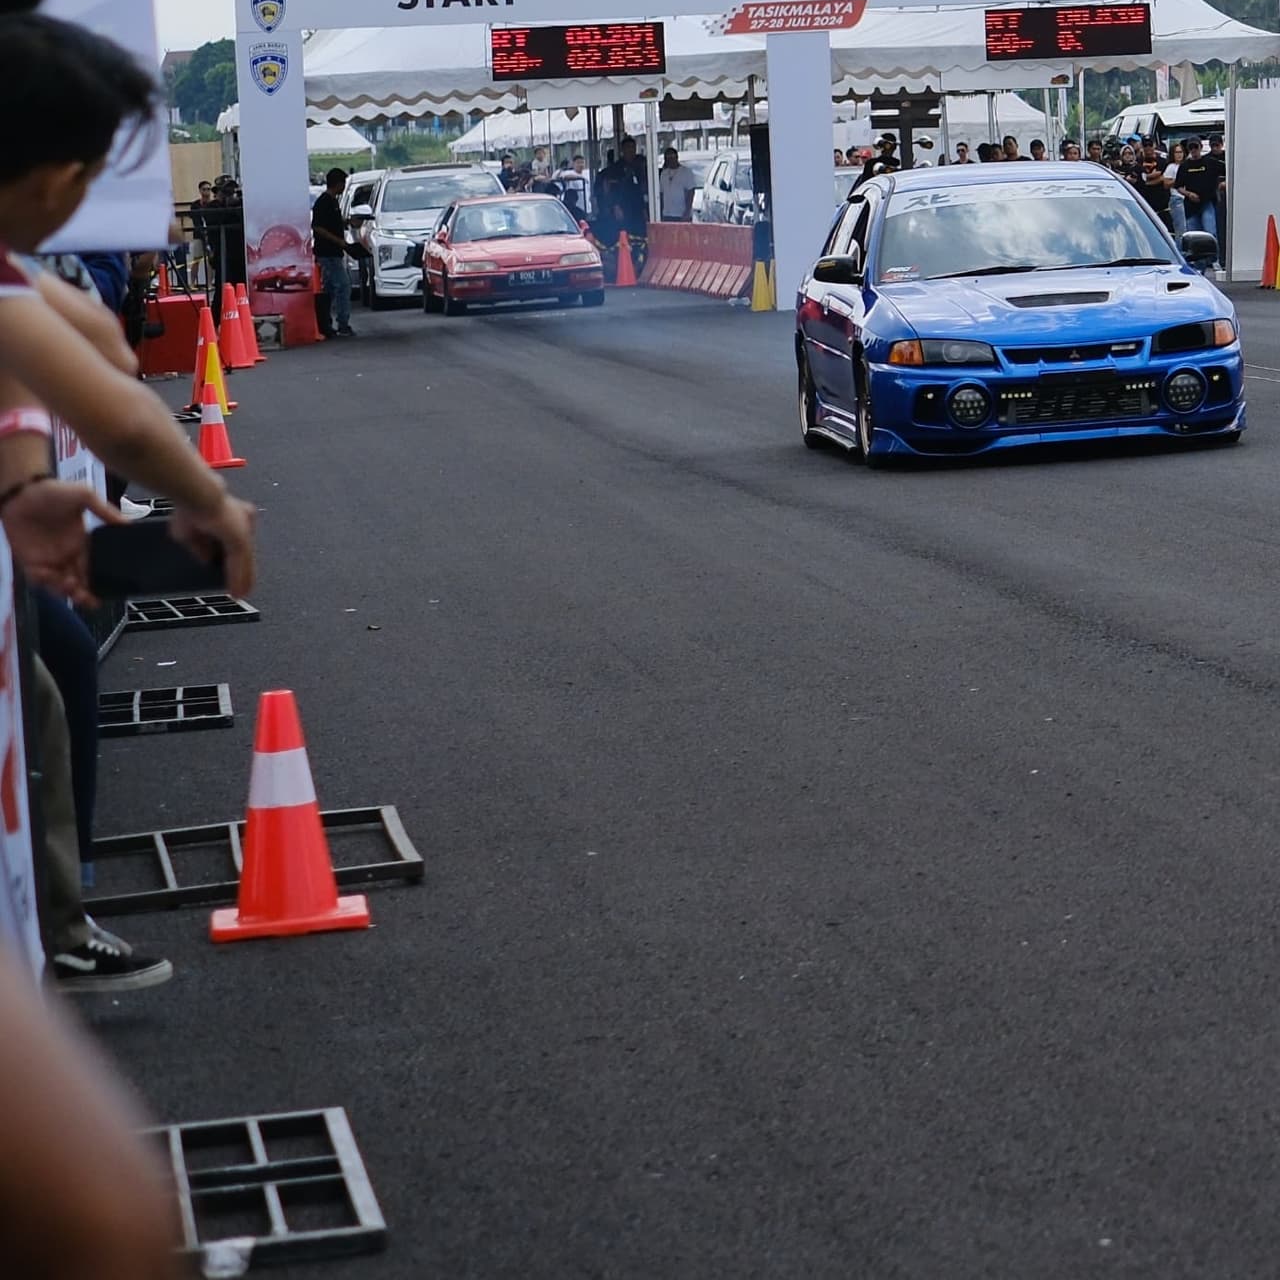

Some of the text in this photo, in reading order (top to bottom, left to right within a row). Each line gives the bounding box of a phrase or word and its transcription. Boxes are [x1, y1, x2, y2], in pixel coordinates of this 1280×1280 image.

[748, 2, 854, 19] TASIKMALAYA
[750, 15, 844, 30] 27-28 JULI 2024
